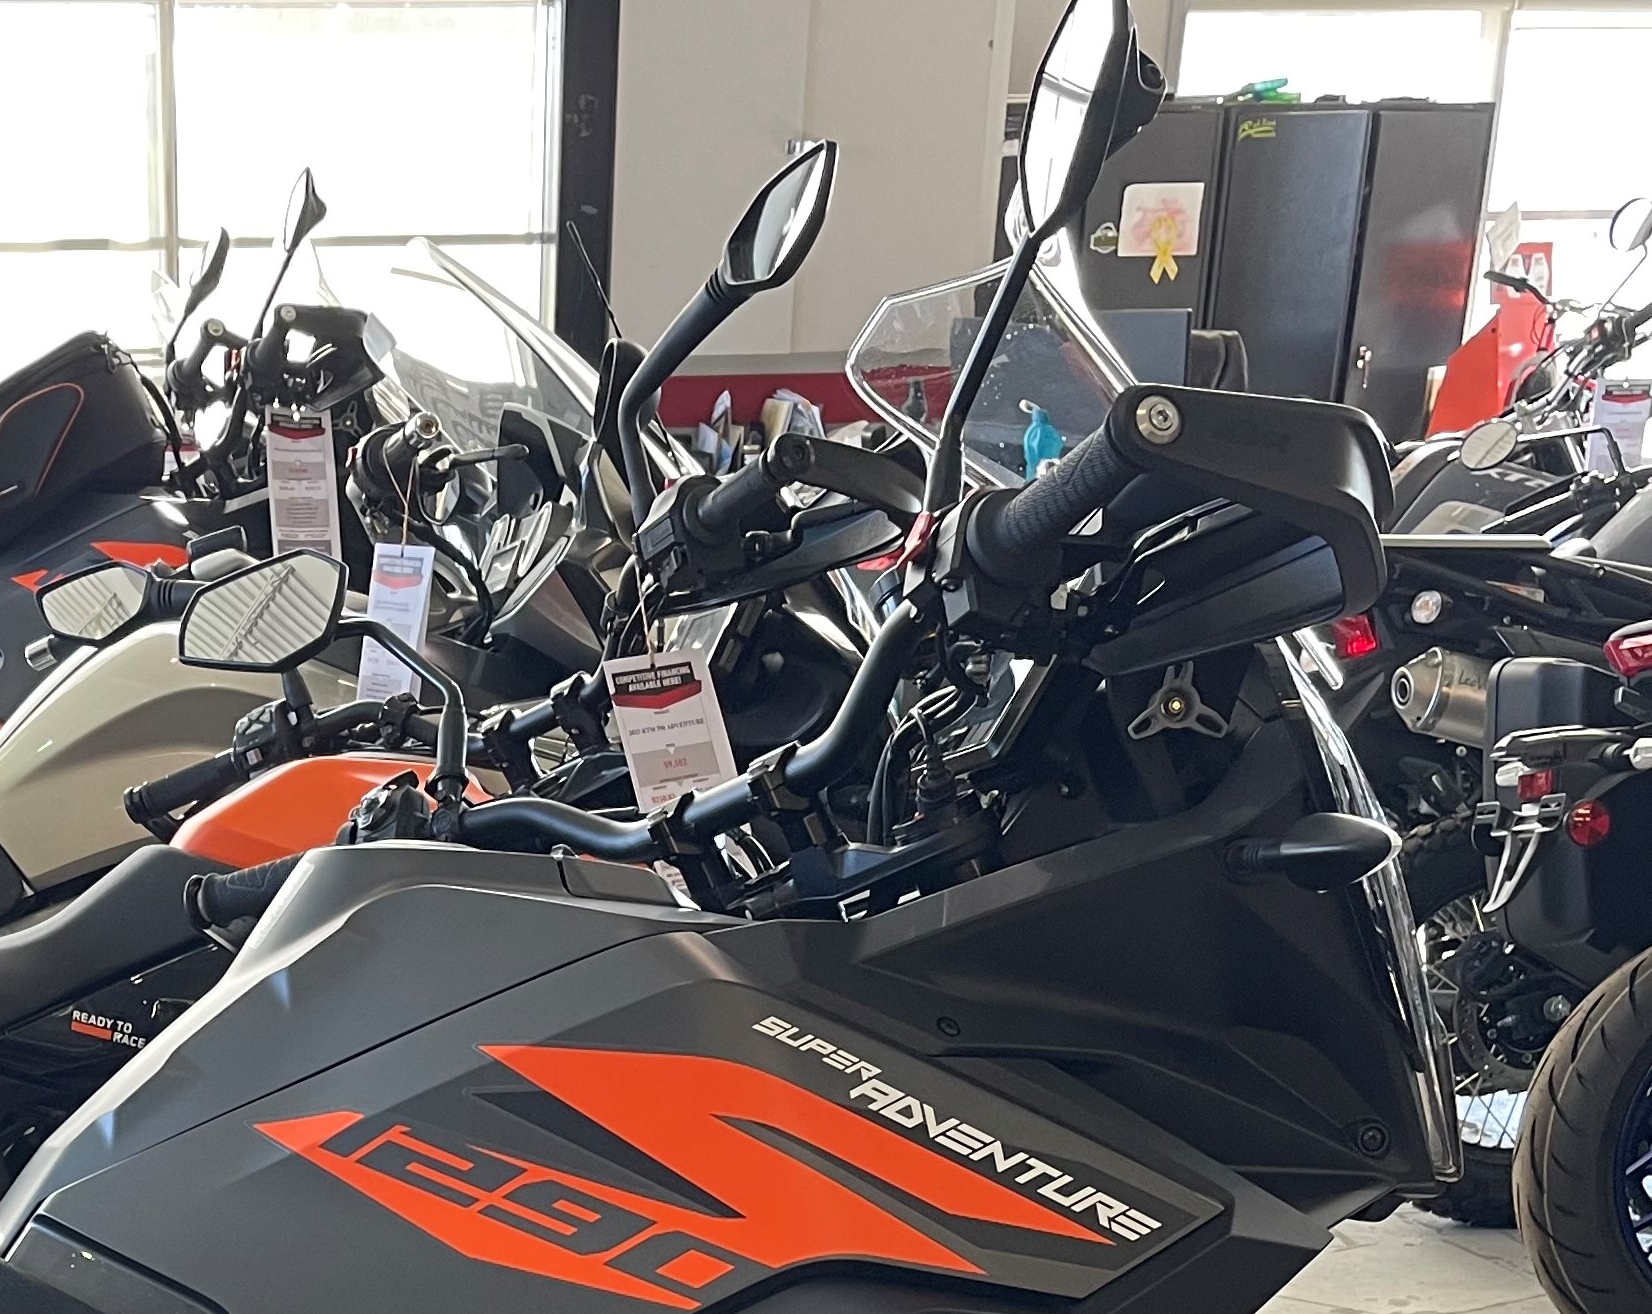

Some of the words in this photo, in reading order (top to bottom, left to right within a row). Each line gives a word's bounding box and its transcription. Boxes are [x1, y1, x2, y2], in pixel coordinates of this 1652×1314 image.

[72, 1010, 115, 1029] READY
[116, 1020, 133, 1034] TO
[112, 1031, 146, 1049] RACE
[751, 1015, 882, 1081] SUPER
[849, 1078, 1163, 1241] ADVENTURE
[319, 1114, 776, 1304] 1290
